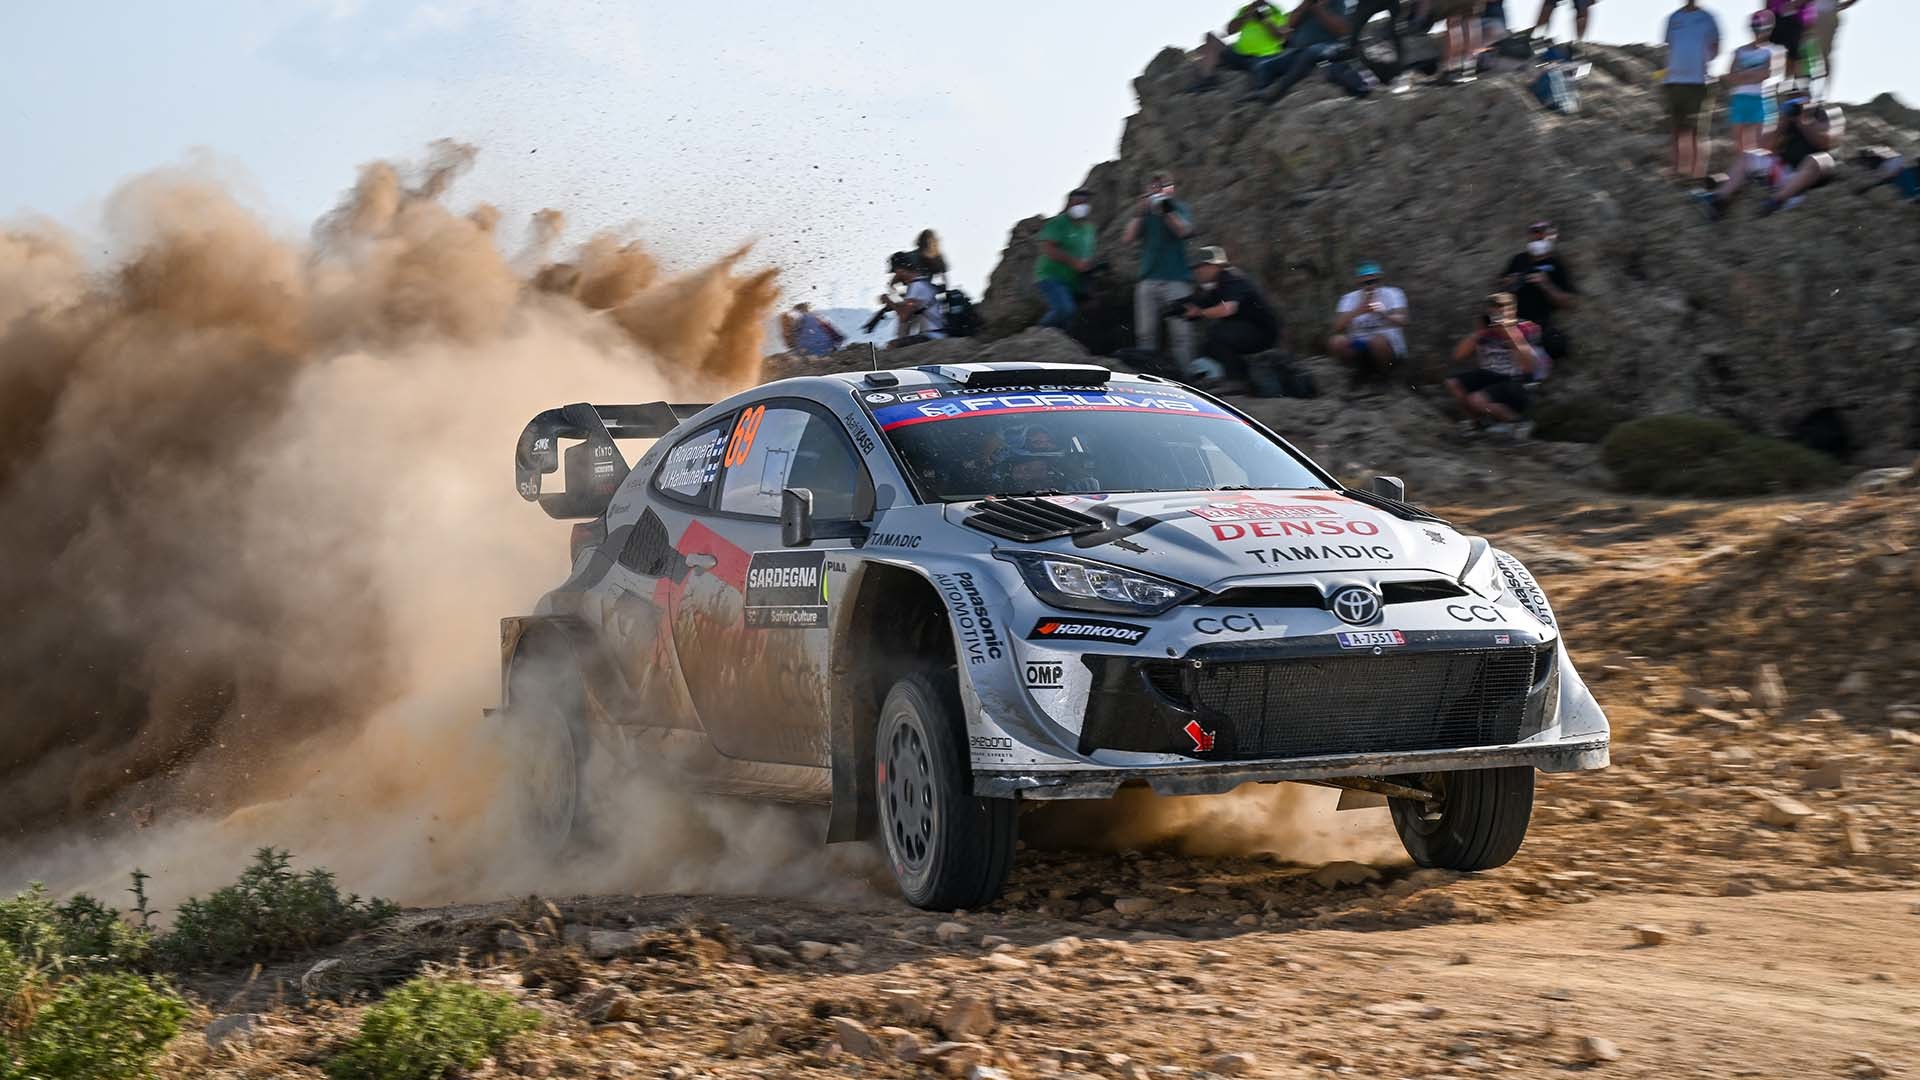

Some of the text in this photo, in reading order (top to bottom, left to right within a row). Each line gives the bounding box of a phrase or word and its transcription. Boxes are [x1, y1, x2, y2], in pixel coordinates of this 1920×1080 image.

[948, 385, 1035, 396] TOYOTA
[1039, 384, 1114, 393] GAZOO
[960, 394, 1200, 412] FORUM8
[724, 404, 766, 468] 69
[1210, 520, 1380, 542] DENSO
[870, 533, 922, 549] TAMADIC
[1246, 545, 1394, 564] TAMADIC
[827, 561, 847, 573] PIAA
[749, 567, 817, 588] SARDEGNA
[933, 573, 986, 665] AUTOMOTIVE
[952, 572, 1003, 660] Panasonic
[1352, 633, 1393, 645] A-7551
[1026, 666, 1063, 684] OMP
